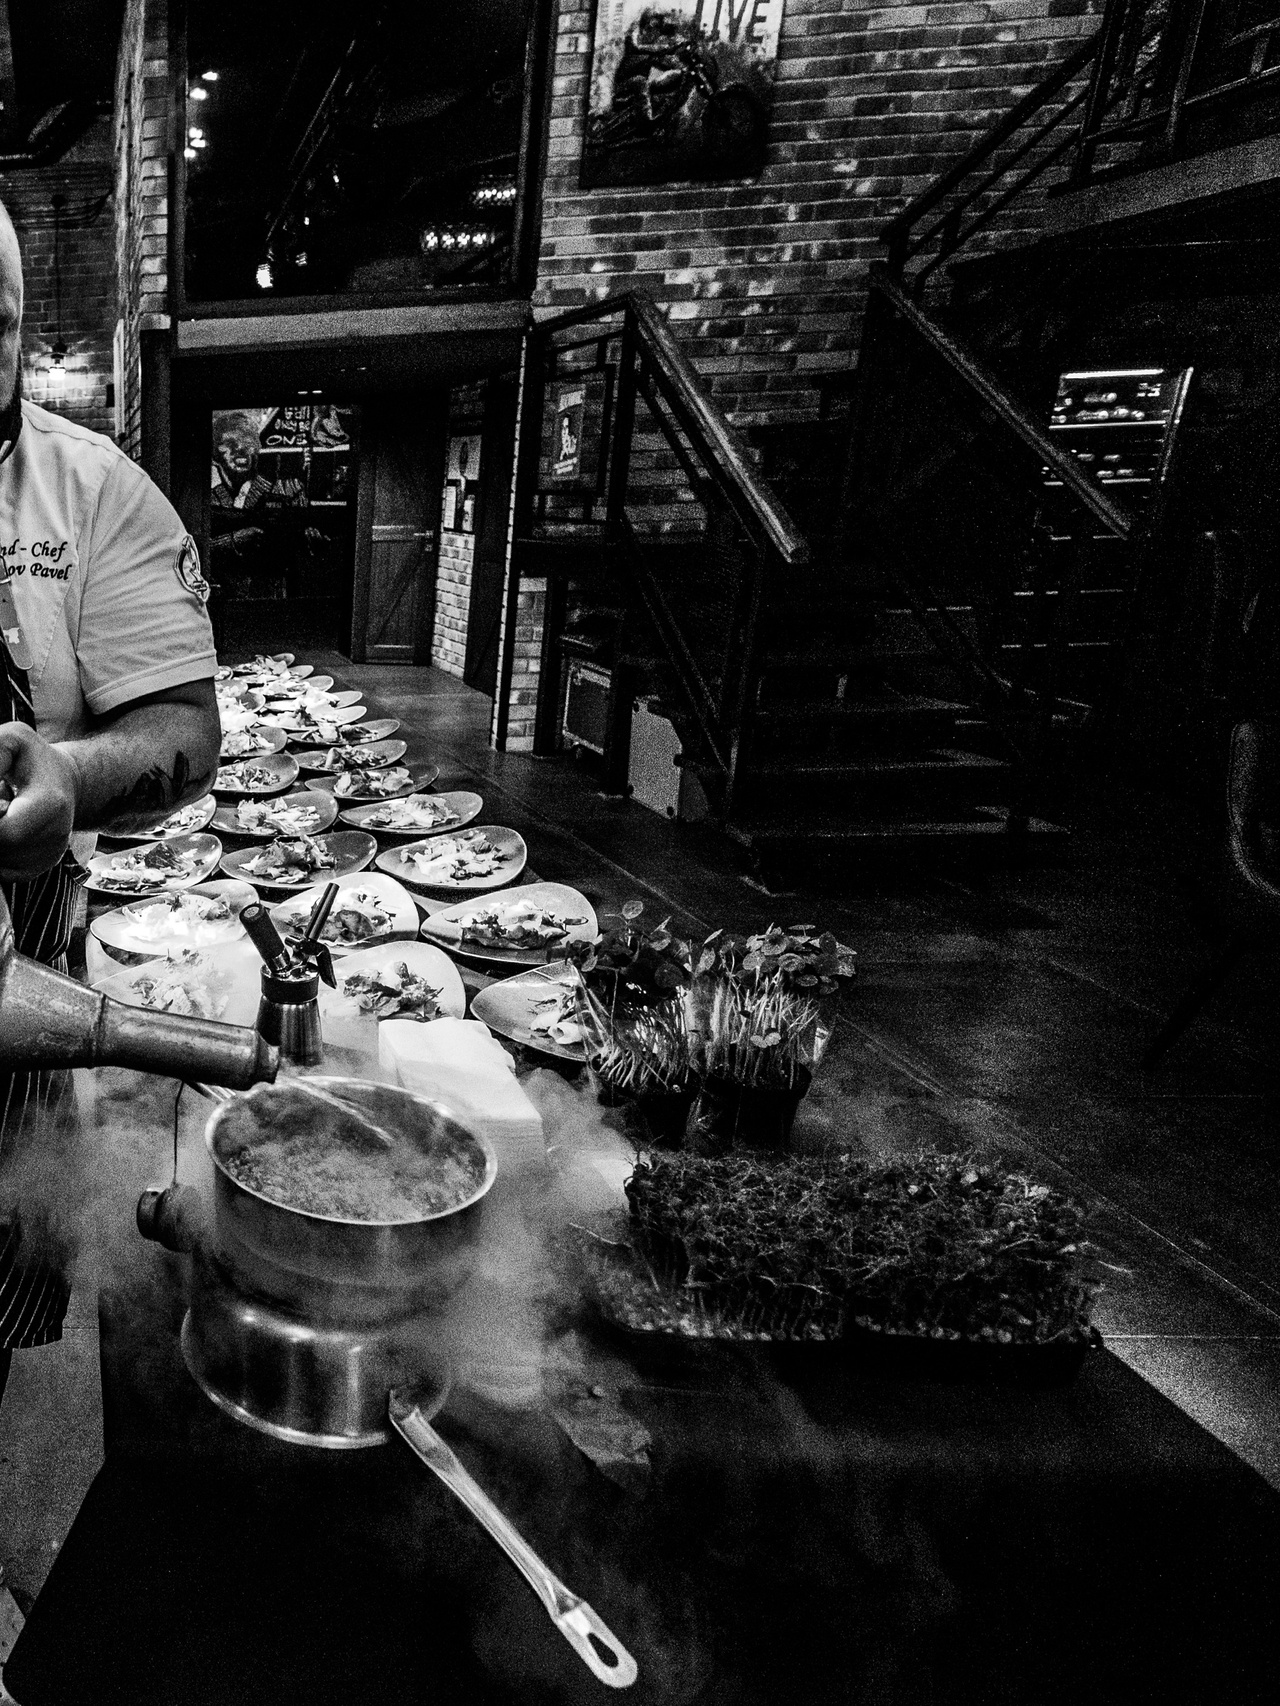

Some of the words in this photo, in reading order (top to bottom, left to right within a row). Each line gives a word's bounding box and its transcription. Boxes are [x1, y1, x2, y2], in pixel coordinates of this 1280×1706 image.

[266, 433, 308, 446] ONE
[31, 540, 68, 563] Chef
[29, 562, 73, 580] Pavel
